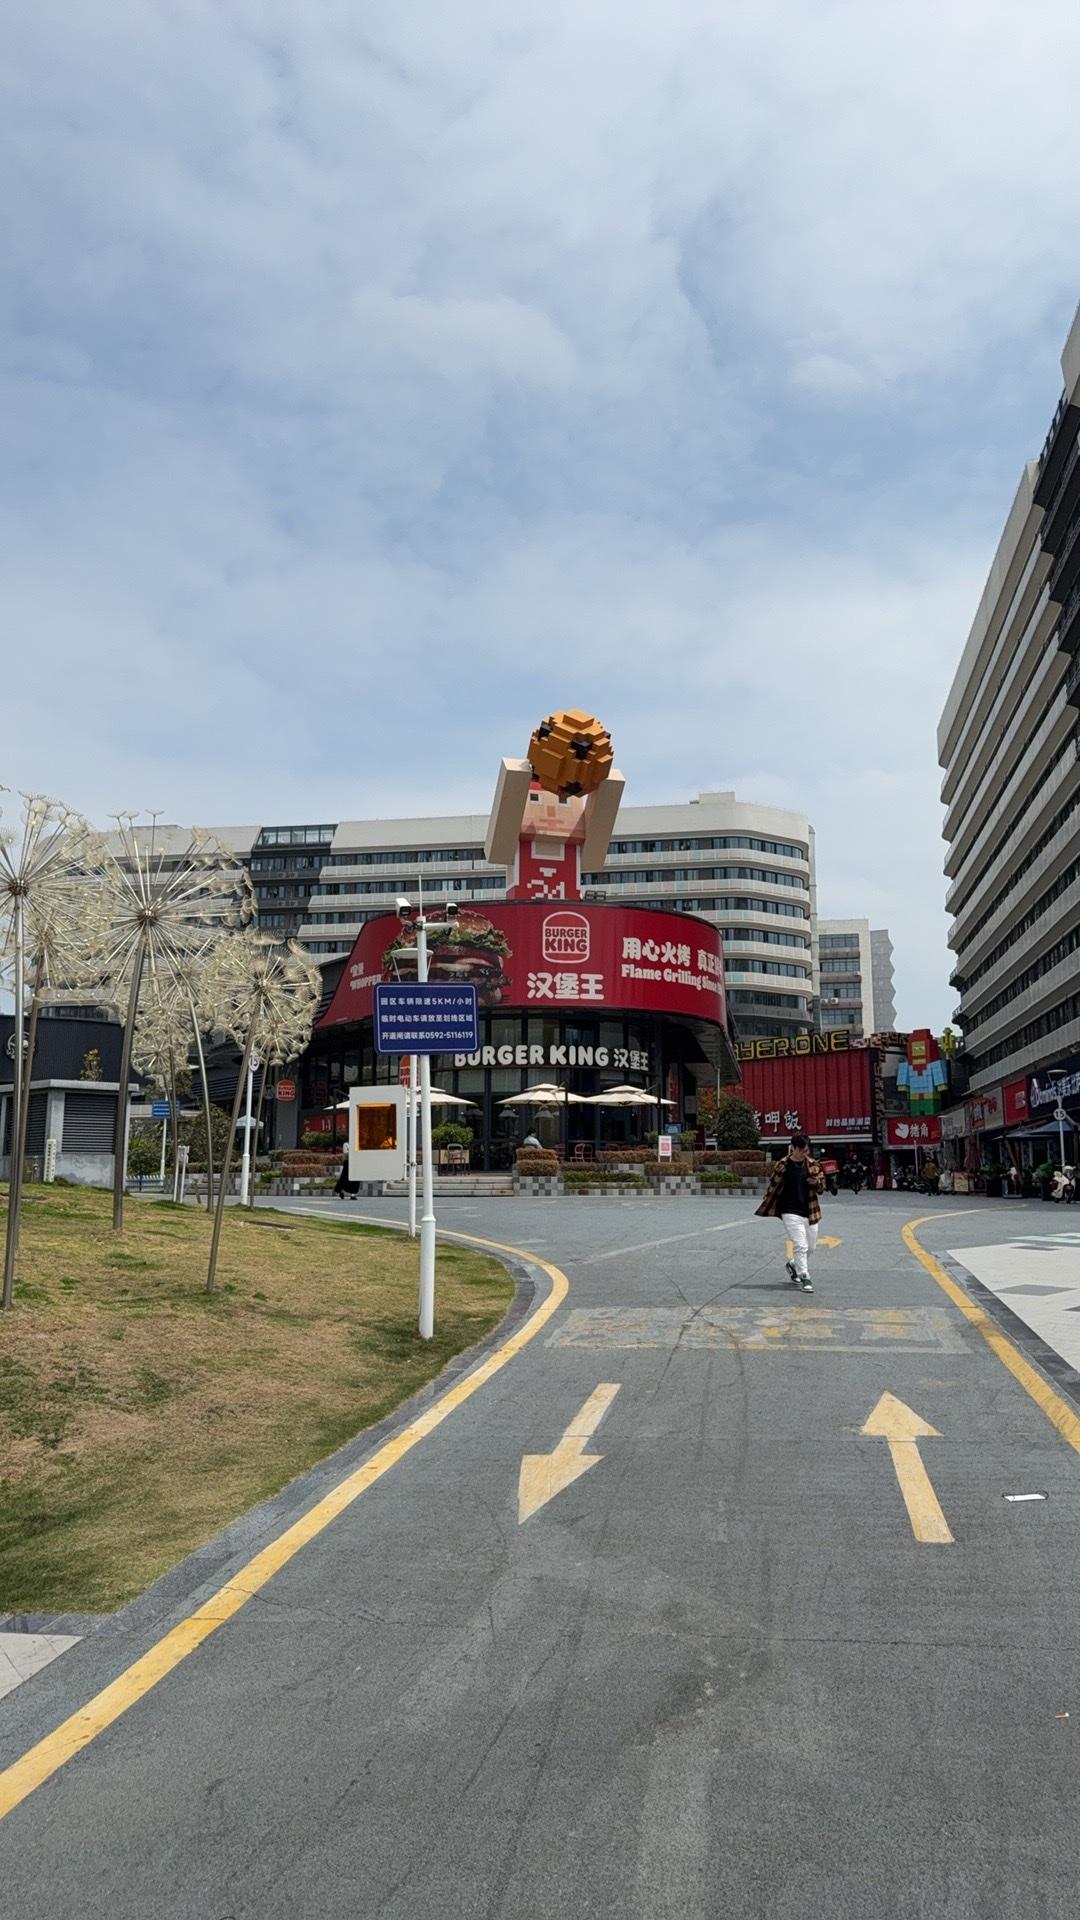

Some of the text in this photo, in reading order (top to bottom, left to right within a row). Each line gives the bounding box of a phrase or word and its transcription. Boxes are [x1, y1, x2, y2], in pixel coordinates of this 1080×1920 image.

[545, 928, 587, 939] BURGER
[545, 938, 587, 952] KING
[621, 937, 692, 967] 用心火烤
[526, 972, 605, 1000] 汉堡王
[621, 964, 662, 981] Flame
[663, 968, 702, 991] Grilling
[795, 1030, 849, 1055] ONE
[454, 1045, 649, 1071] BURGER KING 汉堡王
[1055, 1110, 1064, 1118] 15
